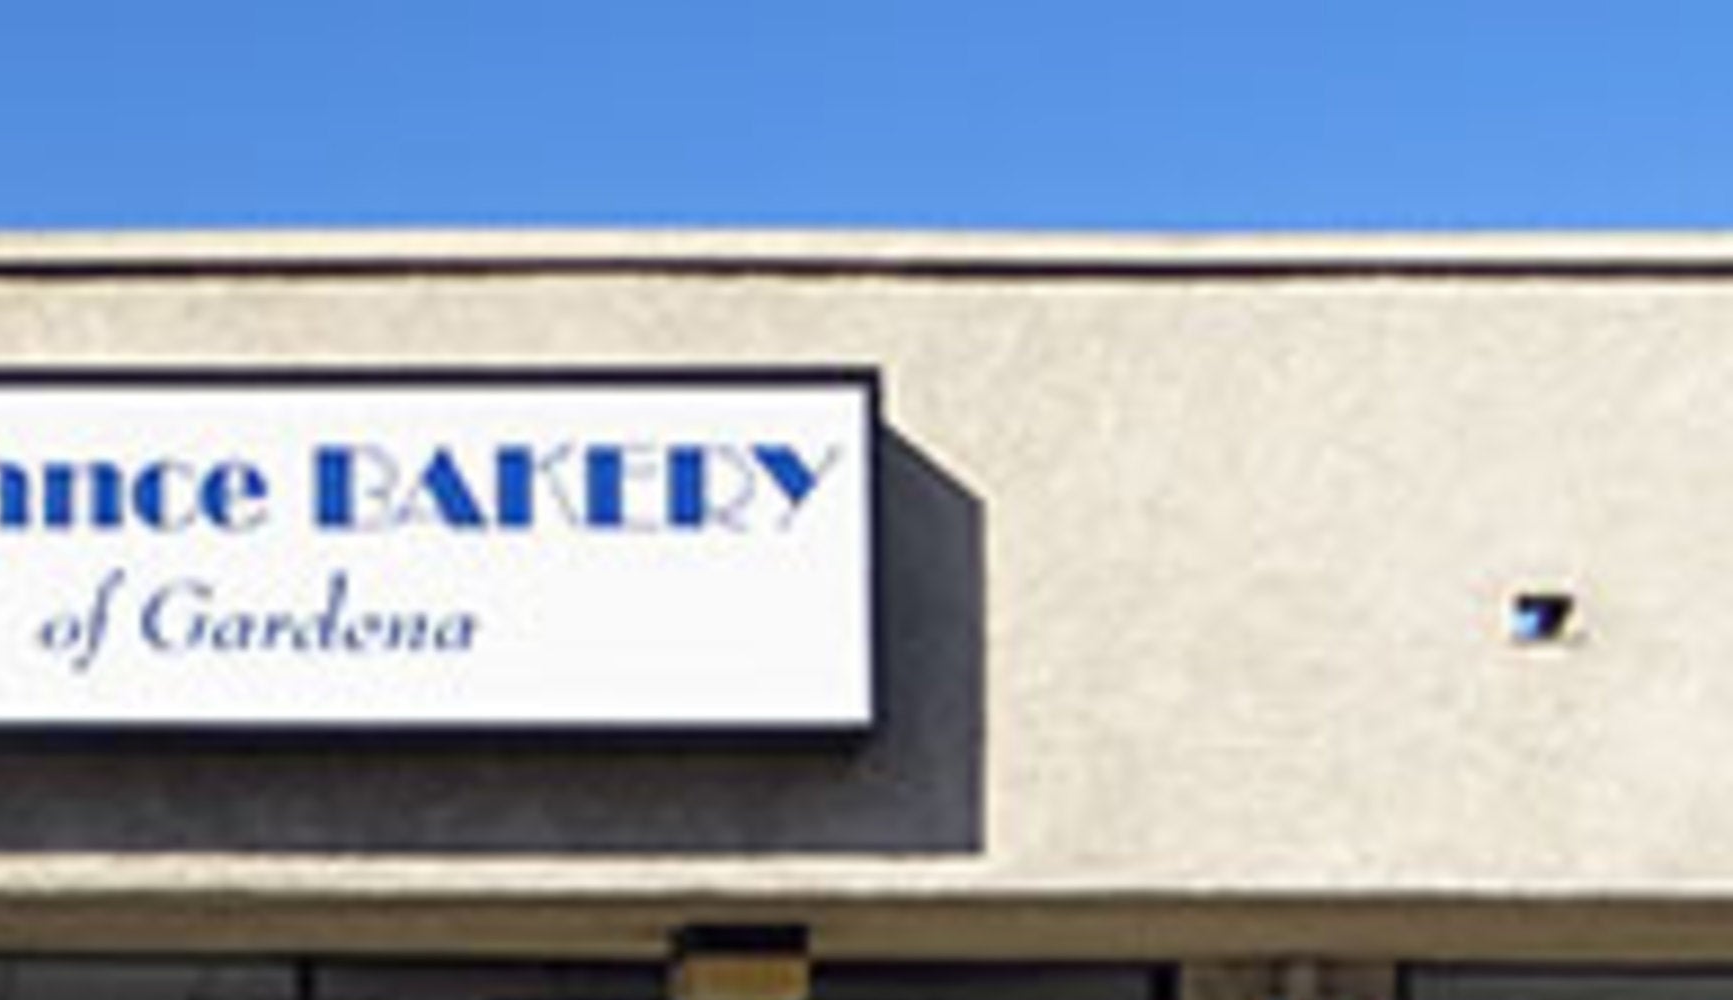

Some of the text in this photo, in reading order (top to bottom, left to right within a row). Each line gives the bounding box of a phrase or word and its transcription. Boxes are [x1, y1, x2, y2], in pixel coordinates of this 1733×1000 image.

[309, 442, 843, 535] BAKERY
[35, 567, 480, 674] of Gardena
